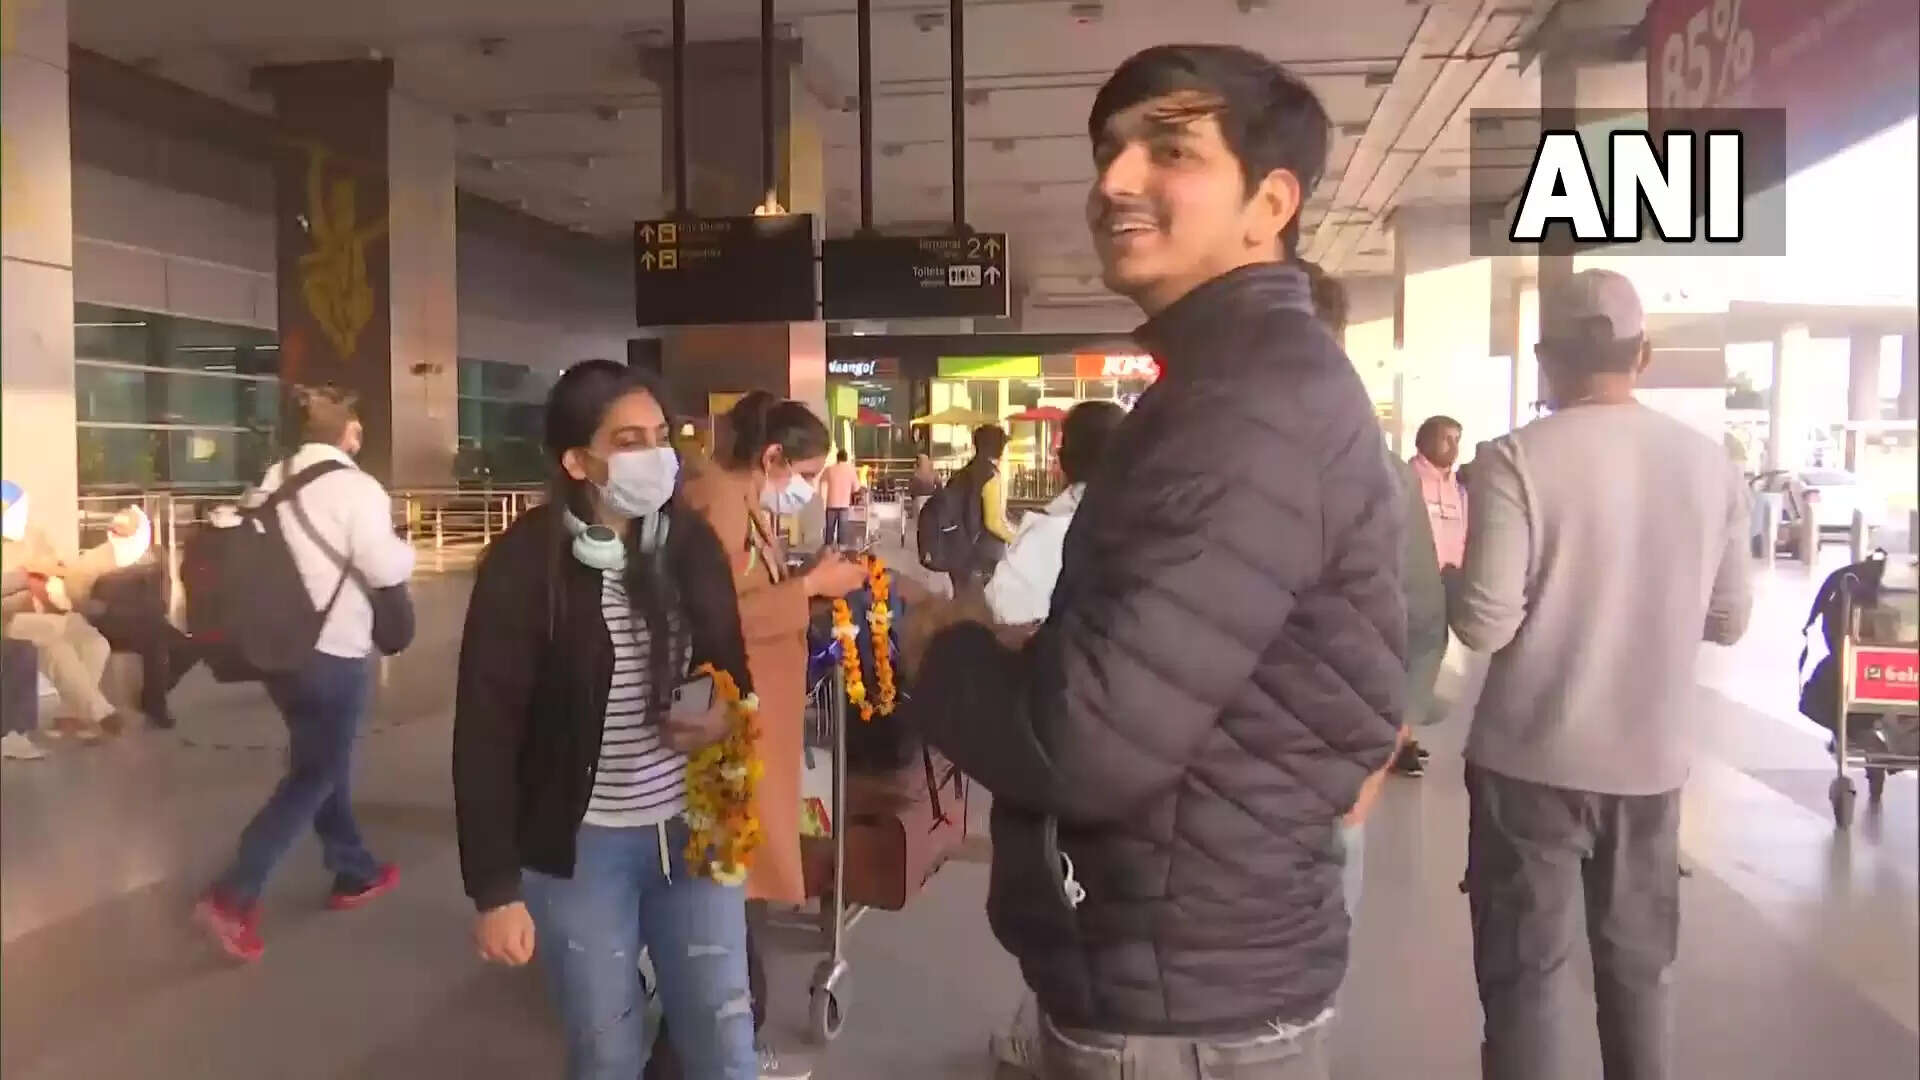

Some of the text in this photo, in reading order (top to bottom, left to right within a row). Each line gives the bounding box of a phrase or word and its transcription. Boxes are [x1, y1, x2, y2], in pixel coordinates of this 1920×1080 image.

[1662, 0, 1754, 109] 85%
[967, 237, 981, 259] 2
[912, 265, 945, 277] Toilets
